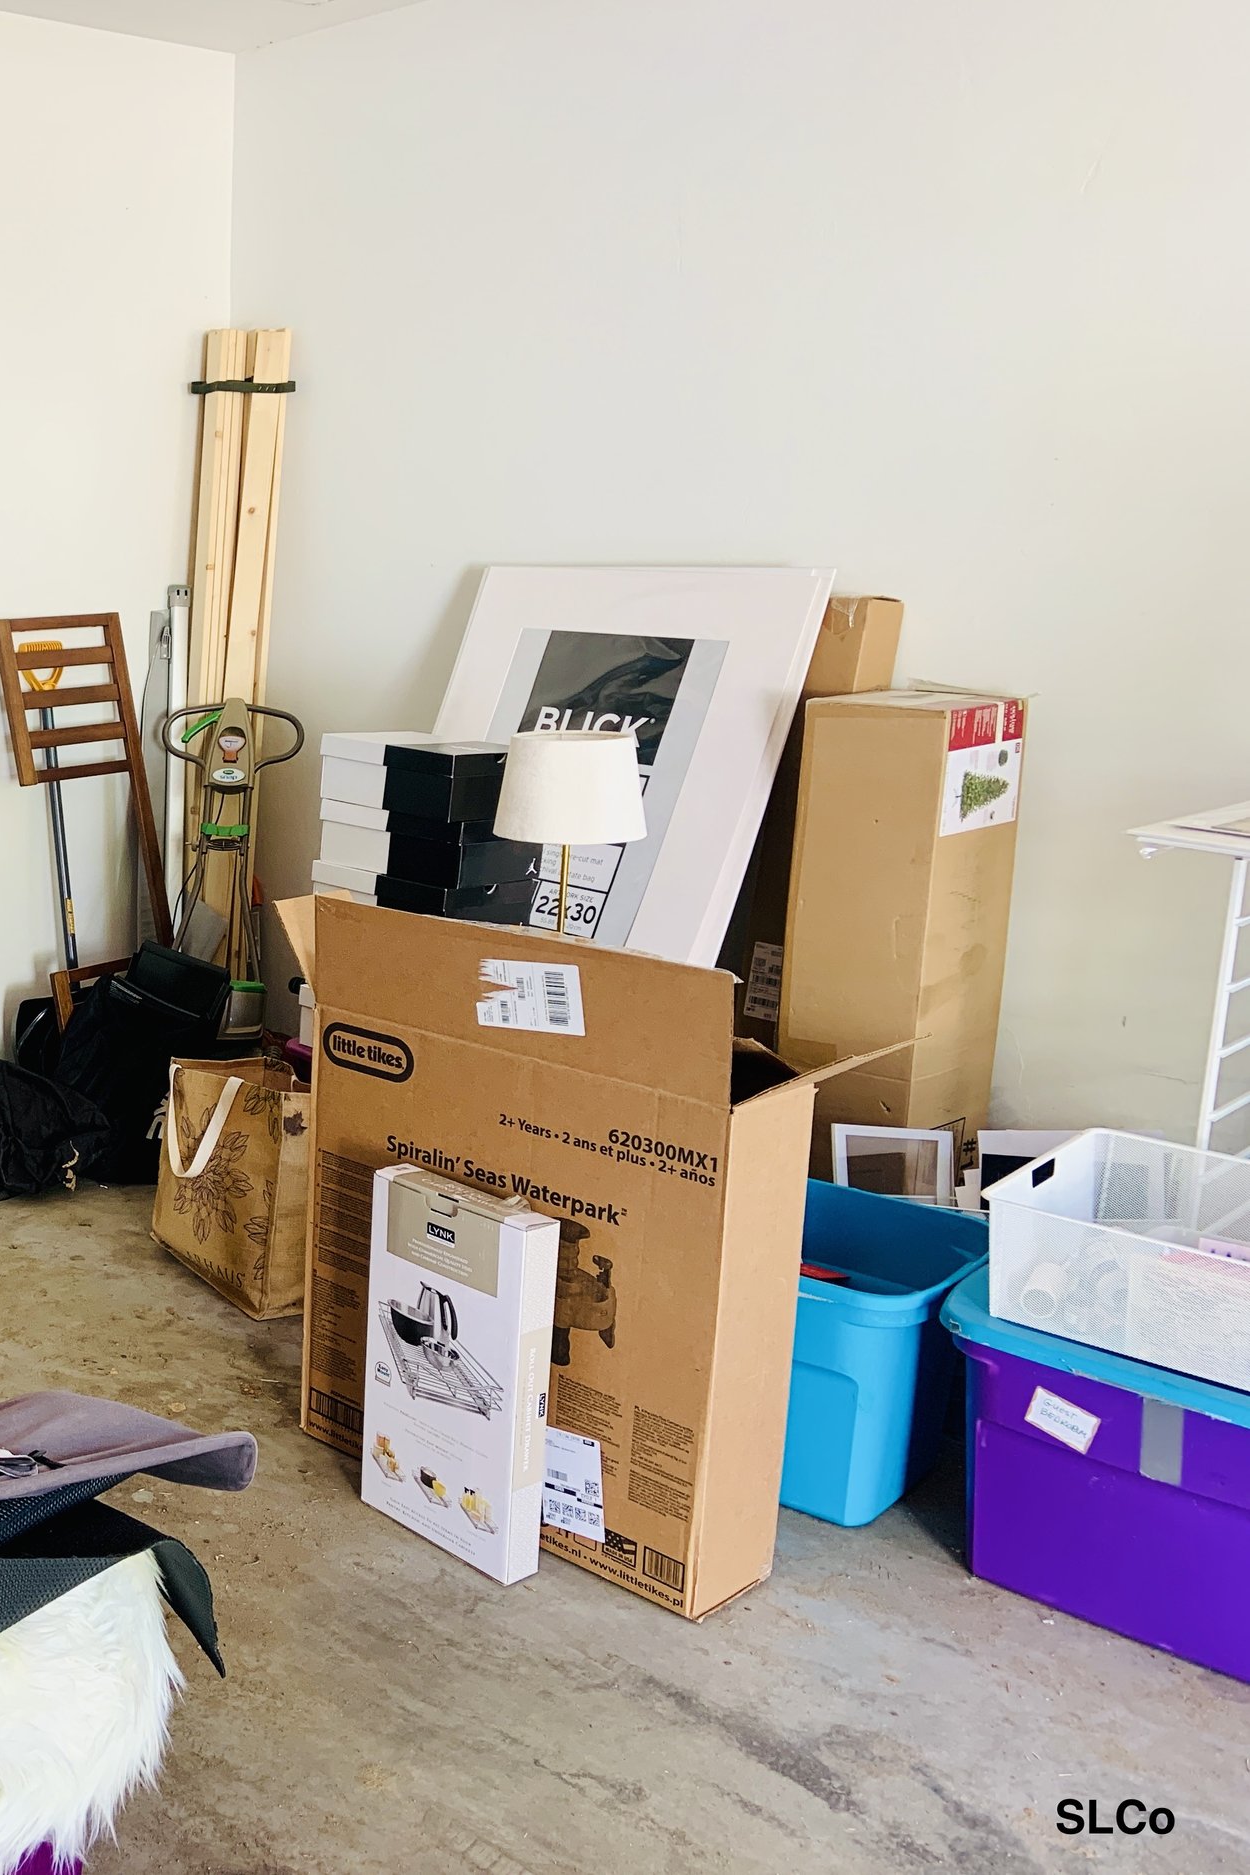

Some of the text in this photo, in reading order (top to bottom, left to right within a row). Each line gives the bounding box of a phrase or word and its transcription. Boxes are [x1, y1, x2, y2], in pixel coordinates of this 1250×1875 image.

[580, 894, 594, 903] SIZE
[332, 1034, 403, 1069] little tikes
[498, 1113, 716, 1187] 2+ Years 2 ans et plus 2+ años
[607, 1128, 718, 1173] 620300MX1
[464, 1159, 507, 1188] Seas
[428, 1224, 454, 1241] LYNK
[589, 1556, 684, 1608] www.littletikes.pl
